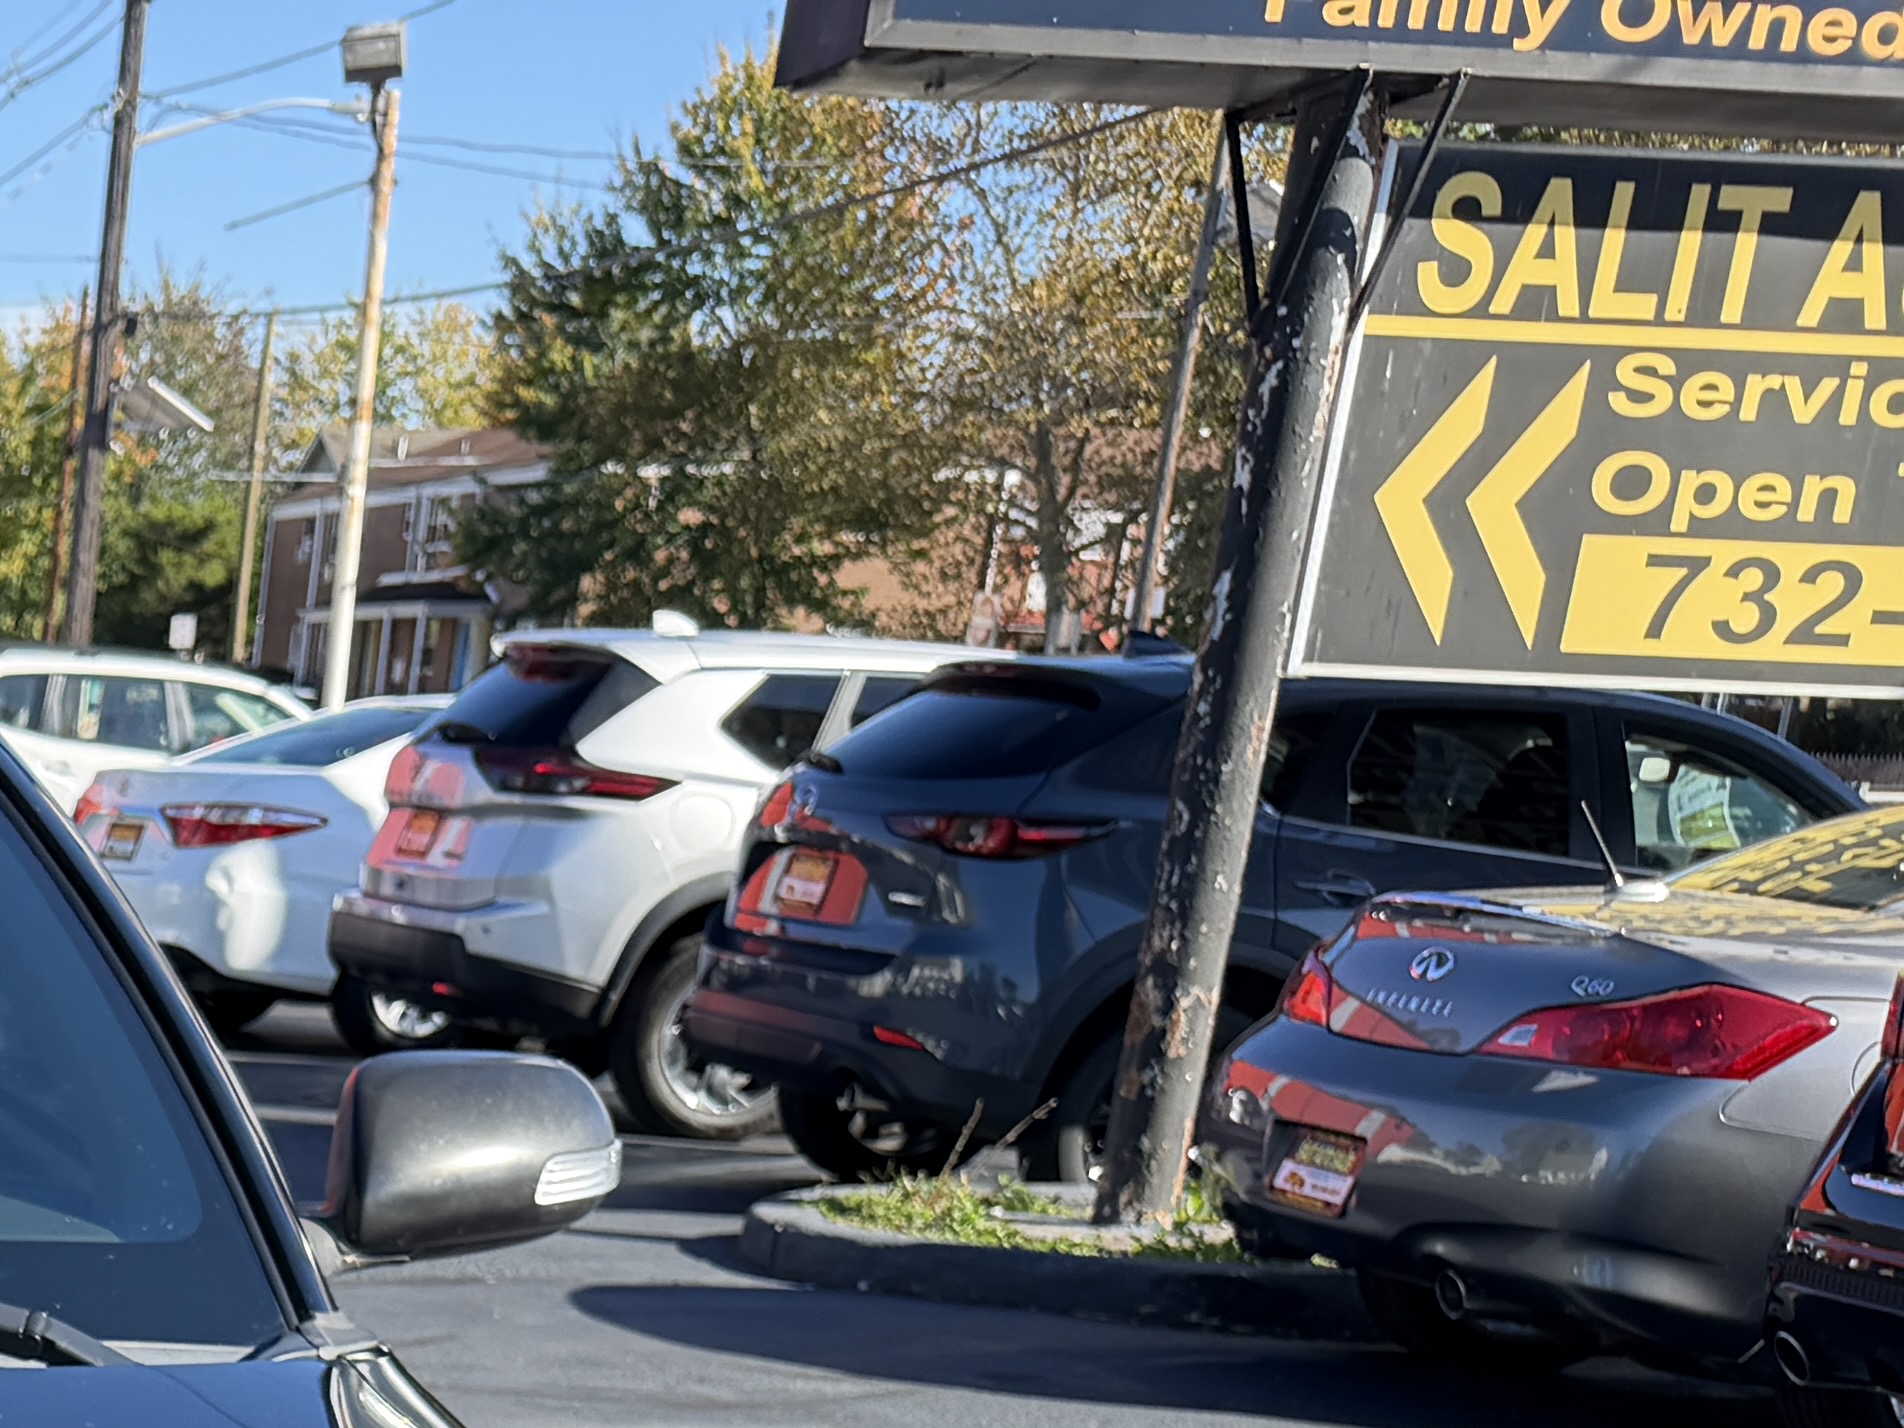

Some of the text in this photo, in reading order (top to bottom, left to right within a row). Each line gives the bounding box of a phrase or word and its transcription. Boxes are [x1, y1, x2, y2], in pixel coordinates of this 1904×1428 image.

[1417, 171, 1904, 330] SALIT A
[1591, 450, 1856, 533] Open
